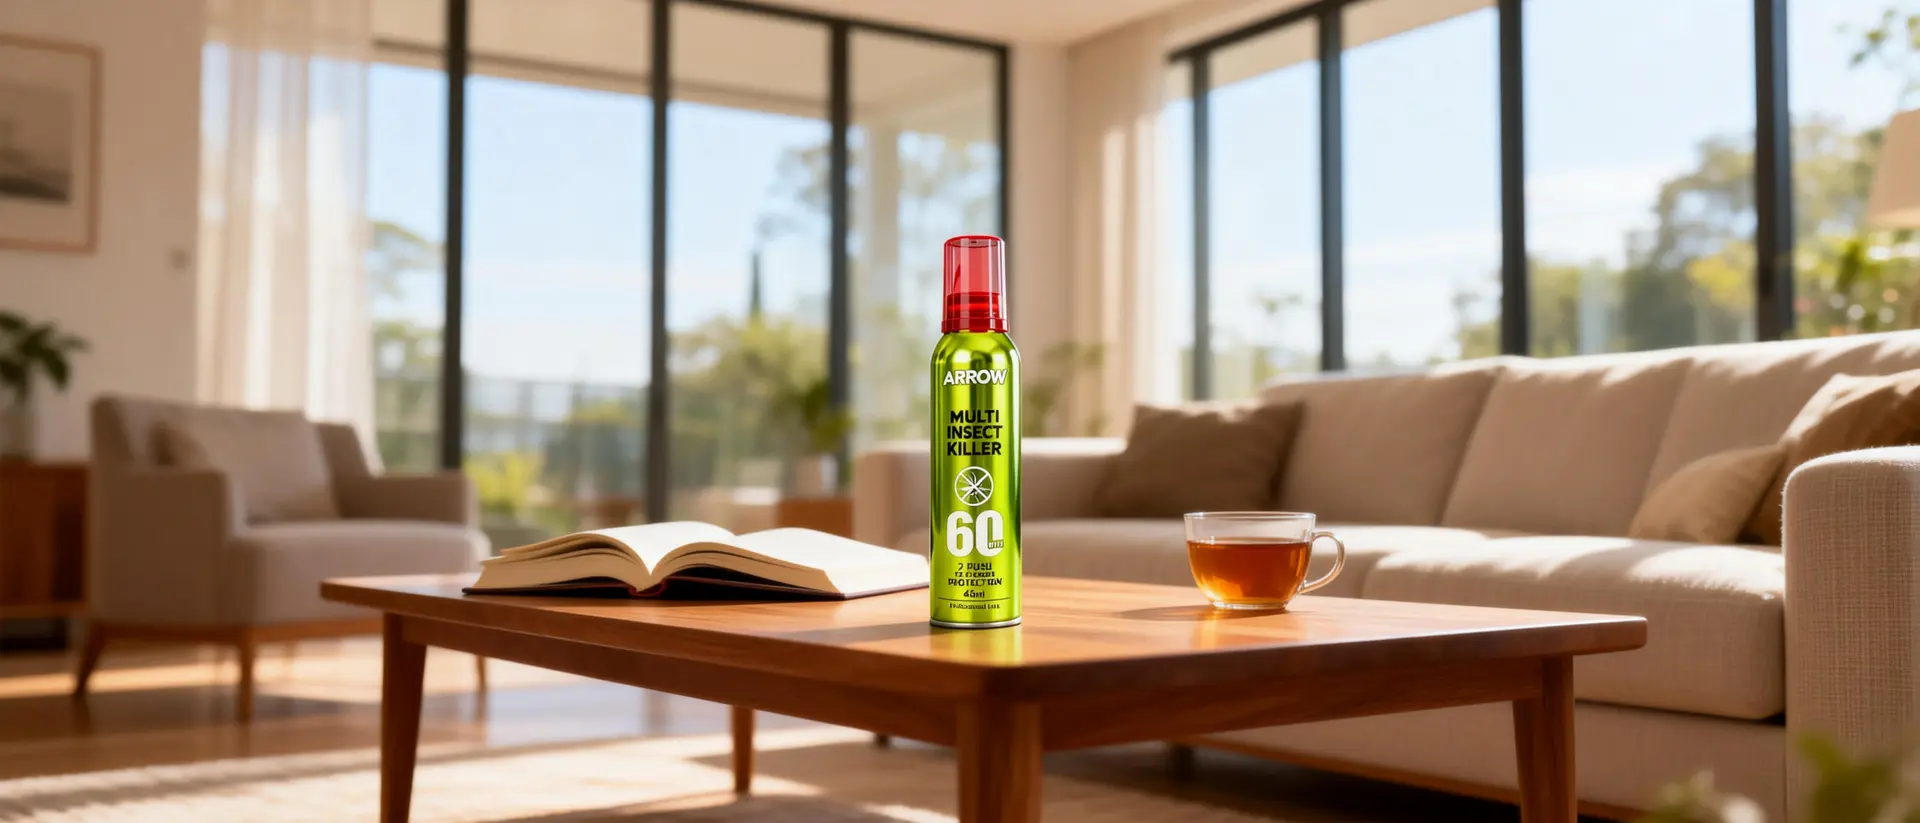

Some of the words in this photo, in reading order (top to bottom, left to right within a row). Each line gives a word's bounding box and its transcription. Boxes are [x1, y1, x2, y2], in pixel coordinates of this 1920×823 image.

[943, 369, 1007, 386] ARROW
[950, 410, 999, 423] MULTI
[947, 426, 1003, 439] INSECT
[947, 442, 1002, 456] KILLER
[947, 510, 1004, 557] 60
